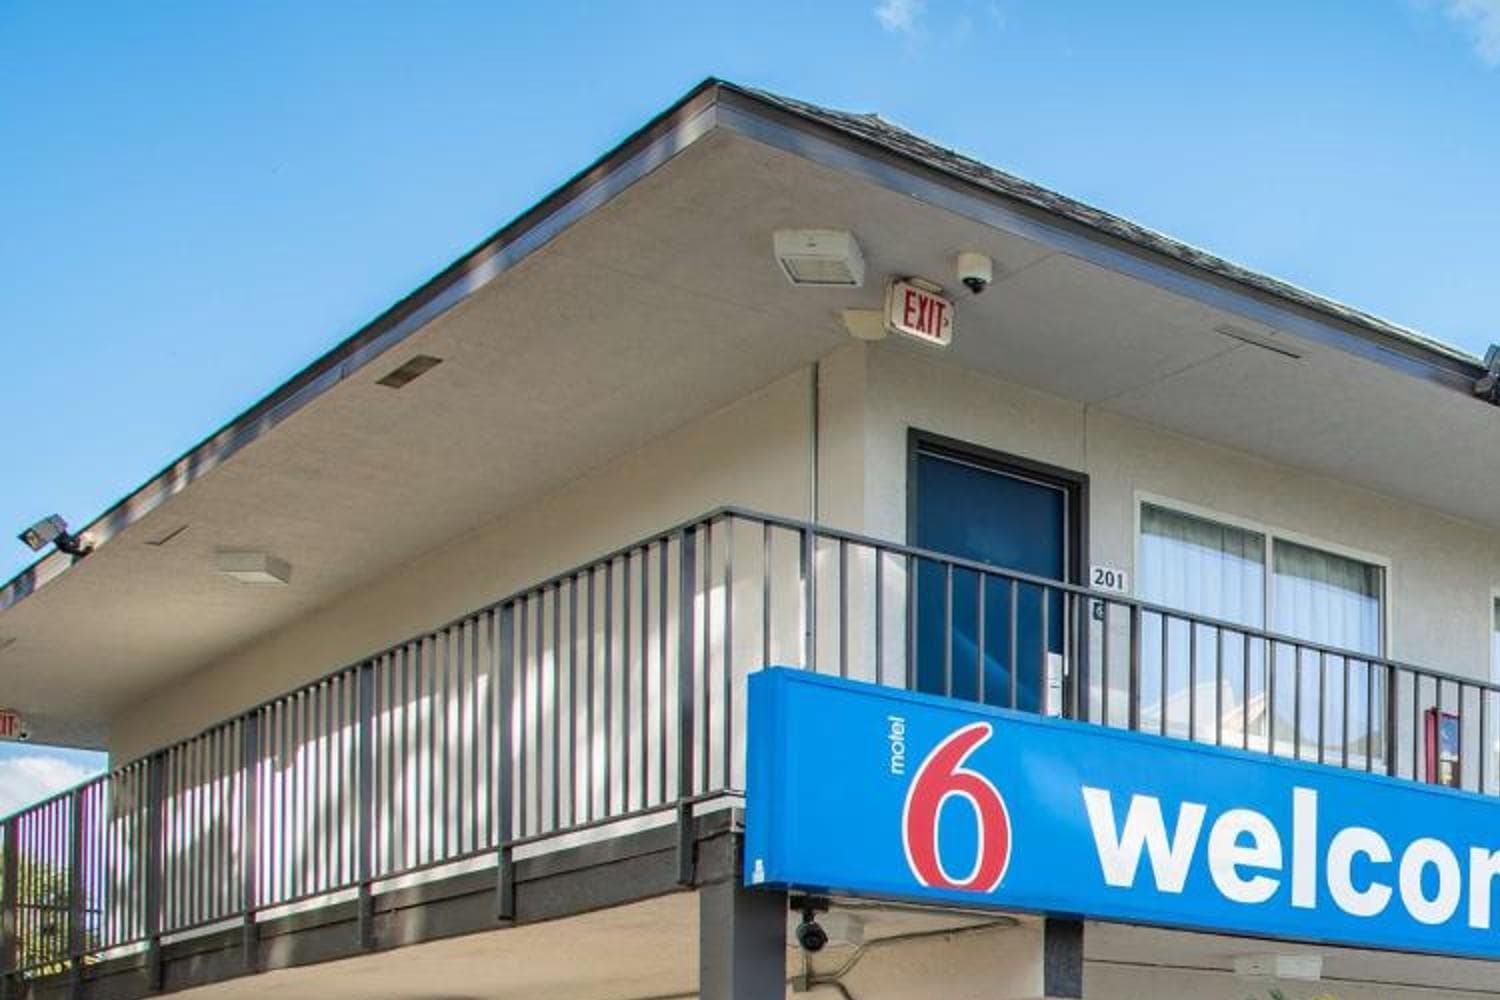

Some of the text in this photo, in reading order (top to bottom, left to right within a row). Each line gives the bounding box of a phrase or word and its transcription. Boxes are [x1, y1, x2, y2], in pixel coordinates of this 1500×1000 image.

[904, 288, 946, 338] EXIT
[1094, 569, 1123, 590] 201
[888, 715, 906, 775] motel
[902, 721, 1012, 893] 6
